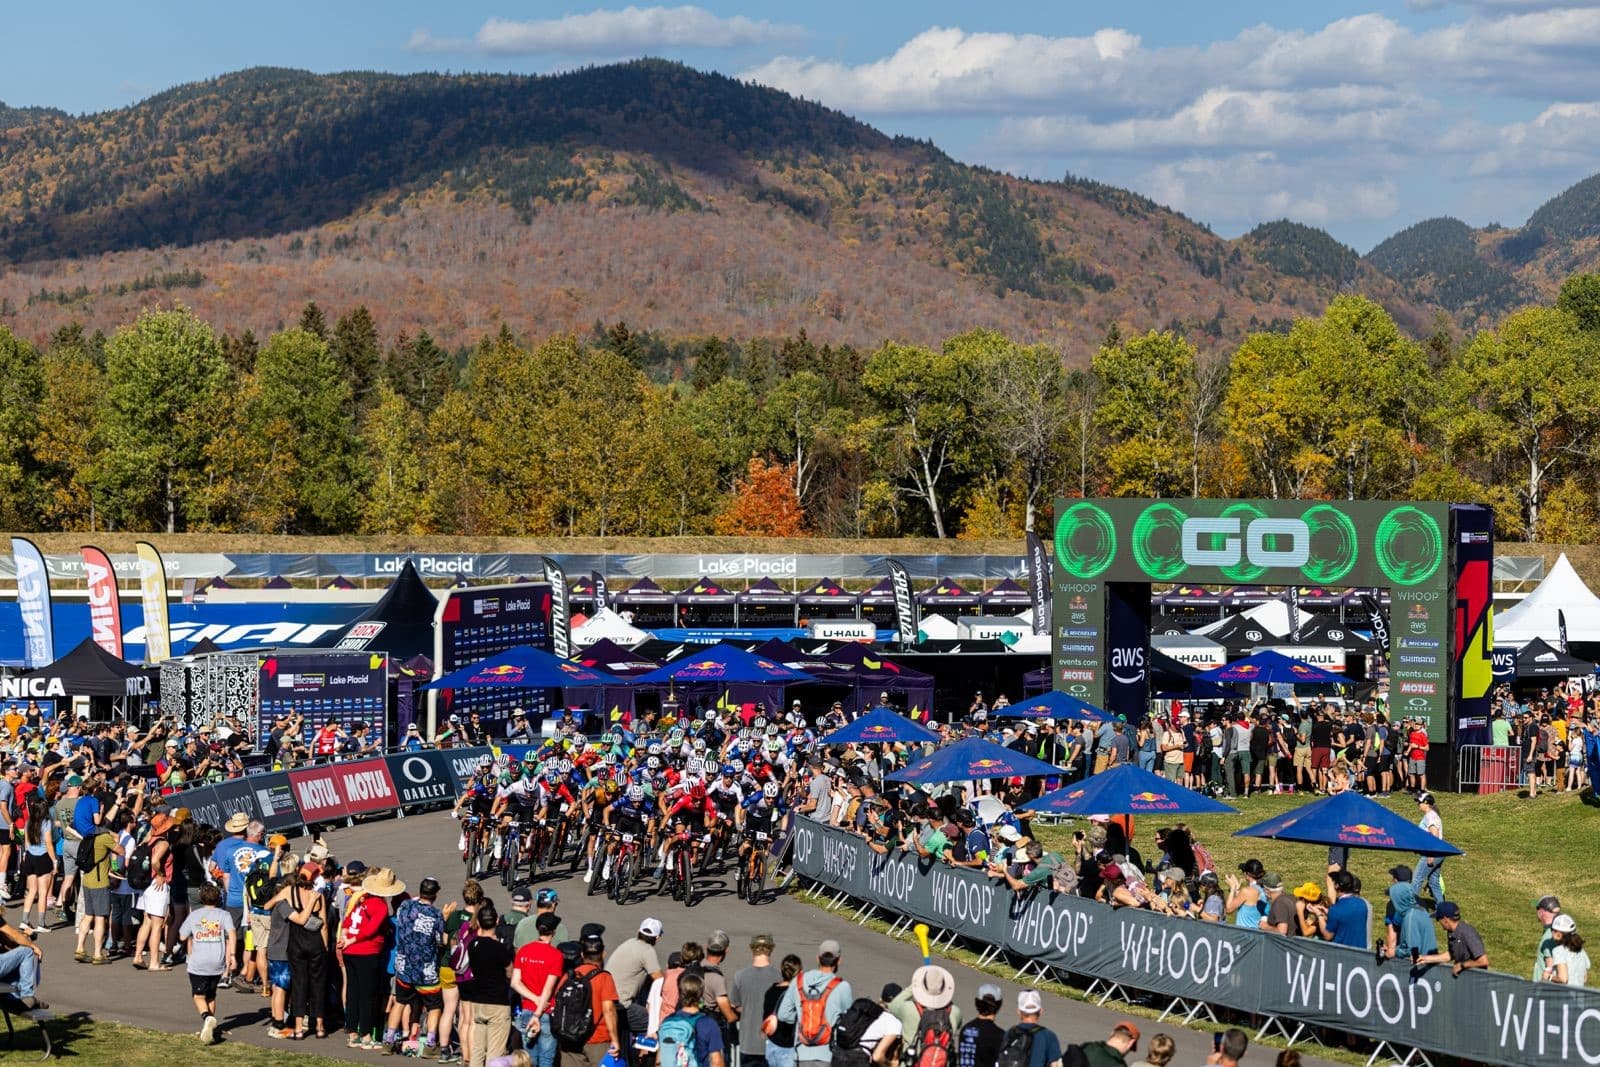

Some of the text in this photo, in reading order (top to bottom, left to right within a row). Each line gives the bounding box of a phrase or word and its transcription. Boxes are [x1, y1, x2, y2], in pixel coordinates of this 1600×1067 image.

[1181, 517, 1310, 566] GO
[61, 562, 78, 571] MT
[375, 557, 473, 572] Lak Placid
[699, 559, 797, 574] Lake Placid
[1059, 584, 1097, 592] WHOOP
[1397, 592, 1439, 601] WHOOP
[1072, 612, 1085, 620] aws
[1411, 622, 1426, 630] aws
[1063, 645, 1094, 653] SHIMANO
[1112, 647, 1145, 667] aws
[330, 676, 346, 684] Lake
[347, 675, 368, 684] Placid
[701, 669, 726, 677] Bull
[1064, 672, 1094, 680] MOTUL
[1401, 684, 1434, 693] MOTUL
[991, 765, 1014, 774] Bull
[343, 769, 391, 802] MOTUL
[403, 783, 446, 801] OAKLEY
[297, 778, 341, 810] MOTUL
[1156, 801, 1180, 809] Bull
[1338, 833, 1396, 846] Red Bull
[868, 852, 915, 903] WHOOP
[933, 871, 992, 926] WHOOP
[1012, 900, 1089, 957] WHOOP
[1121, 921, 1235, 988] WHOOP
[1286, 951, 1434, 1030] WHOOP
